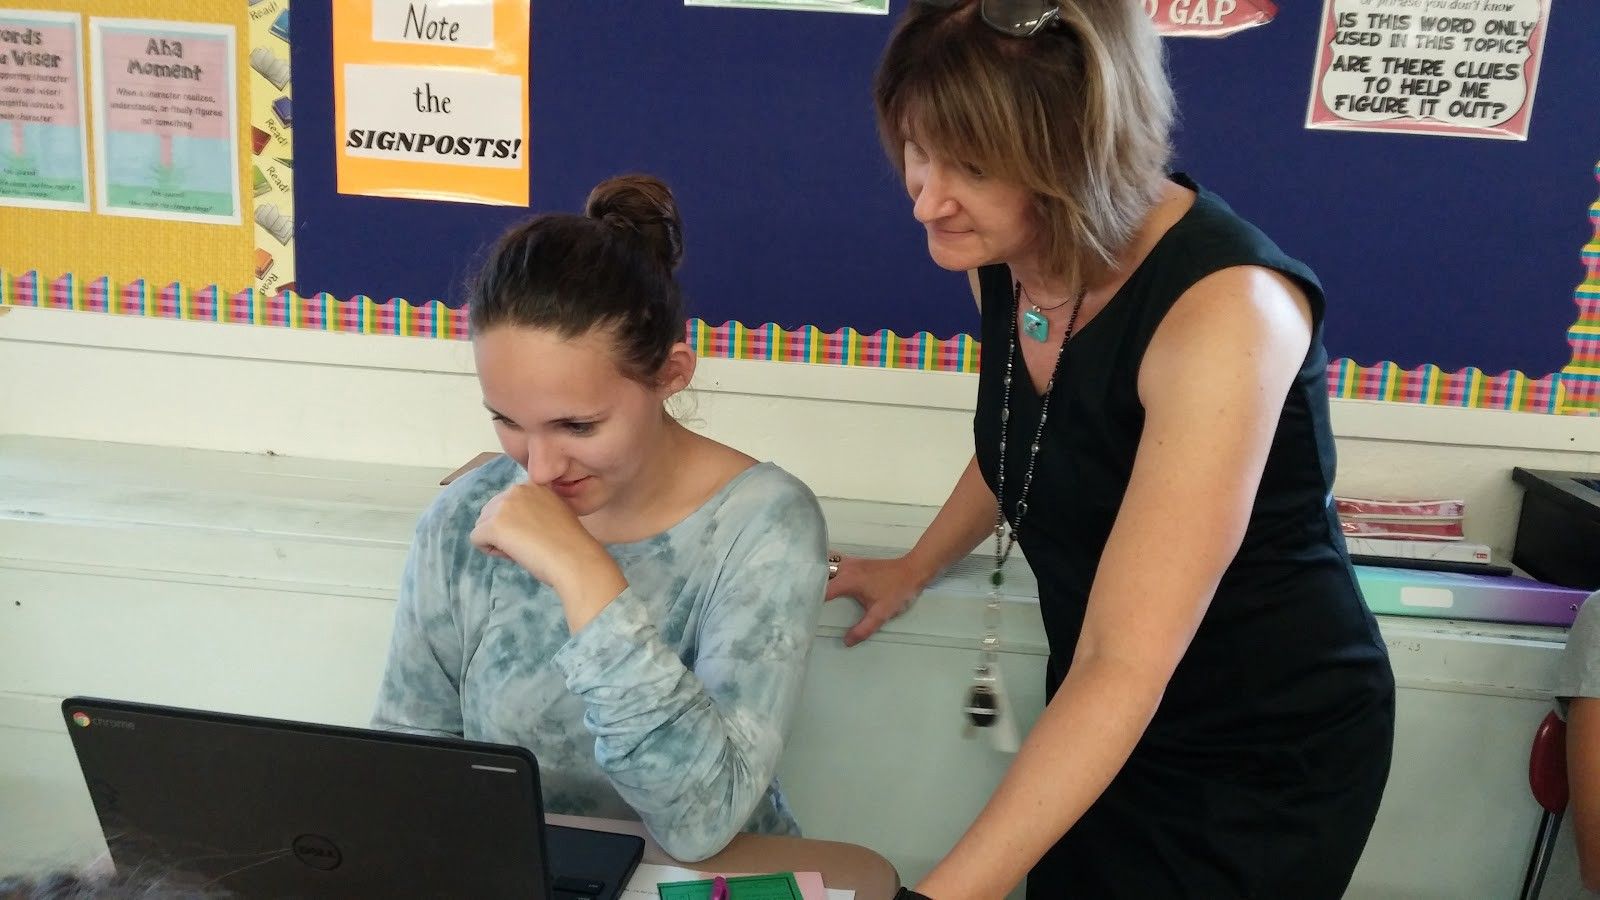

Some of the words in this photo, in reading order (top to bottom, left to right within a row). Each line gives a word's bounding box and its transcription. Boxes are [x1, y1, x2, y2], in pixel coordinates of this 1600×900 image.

[250, 1, 278, 21] Read!
[1168, 0, 1236, 25] GAP
[1483, 1, 1516, 12] know
[403, 3, 460, 41] Note
[1339, 12, 1358, 28] IS
[1368, 13, 1412, 30] THIS
[1421, 15, 1476, 34] WORD
[1484, 19, 1536, 36] ONLY
[0, 28, 42, 45] ords
[146, 38, 183, 58] Aha
[1335, 31, 1382, 47] USED
[1390, 33, 1408, 48] IN
[1415, 34, 1455, 50] THIS
[1463, 37, 1528, 54] TOPIC?
[11, 50, 61, 68] Wiser
[127, 59, 201, 81] Moment
[1333, 55, 1372, 73] ARE
[1382, 57, 1445, 77] THERE
[1454, 61, 1520, 80] CLUES
[413, 83, 451, 114] the
[1364, 76, 1391, 94] TO
[1400, 78, 1450, 97] HELP
[1459, 81, 1491, 99] ME
[1334, 94, 1410, 114] FIGURE
[1419, 98, 1440, 116] IT
[1448, 101, 1507, 120] OUT?
[265, 118, 288, 146] Read!
[346, 129, 522, 159] SIGNPOSTS!
[266, 166, 290, 194] Read!
